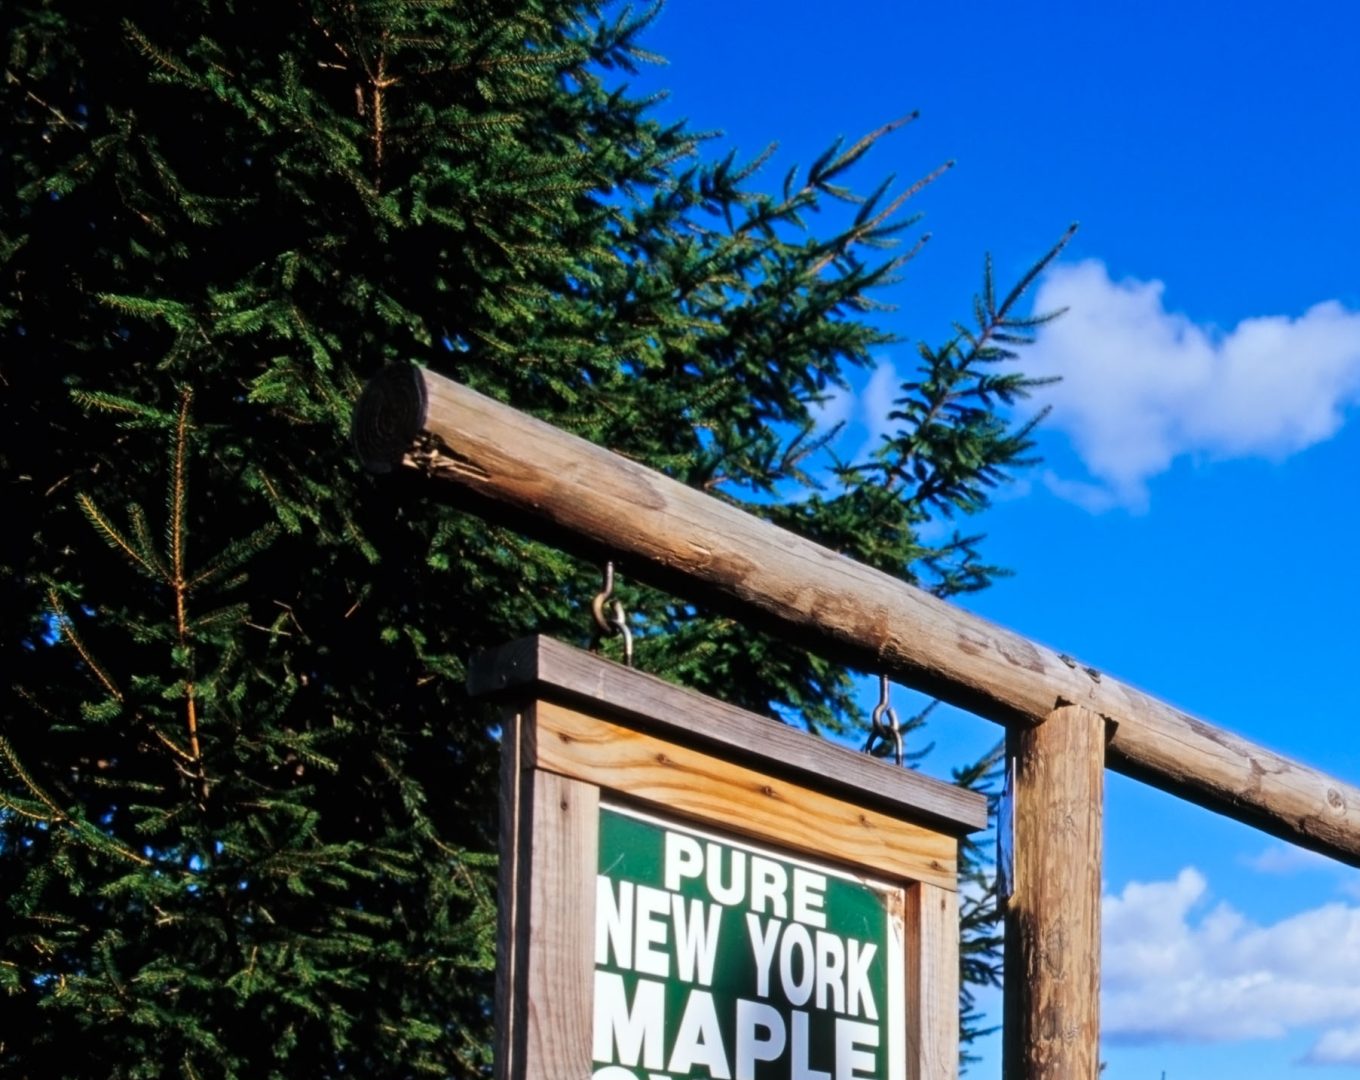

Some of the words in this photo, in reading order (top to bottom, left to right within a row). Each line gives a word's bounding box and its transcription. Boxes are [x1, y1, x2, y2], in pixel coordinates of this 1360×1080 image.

[664, 831, 827, 928] PURE
[596, 875, 722, 986] NEW
[746, 912, 878, 1020] YORK
